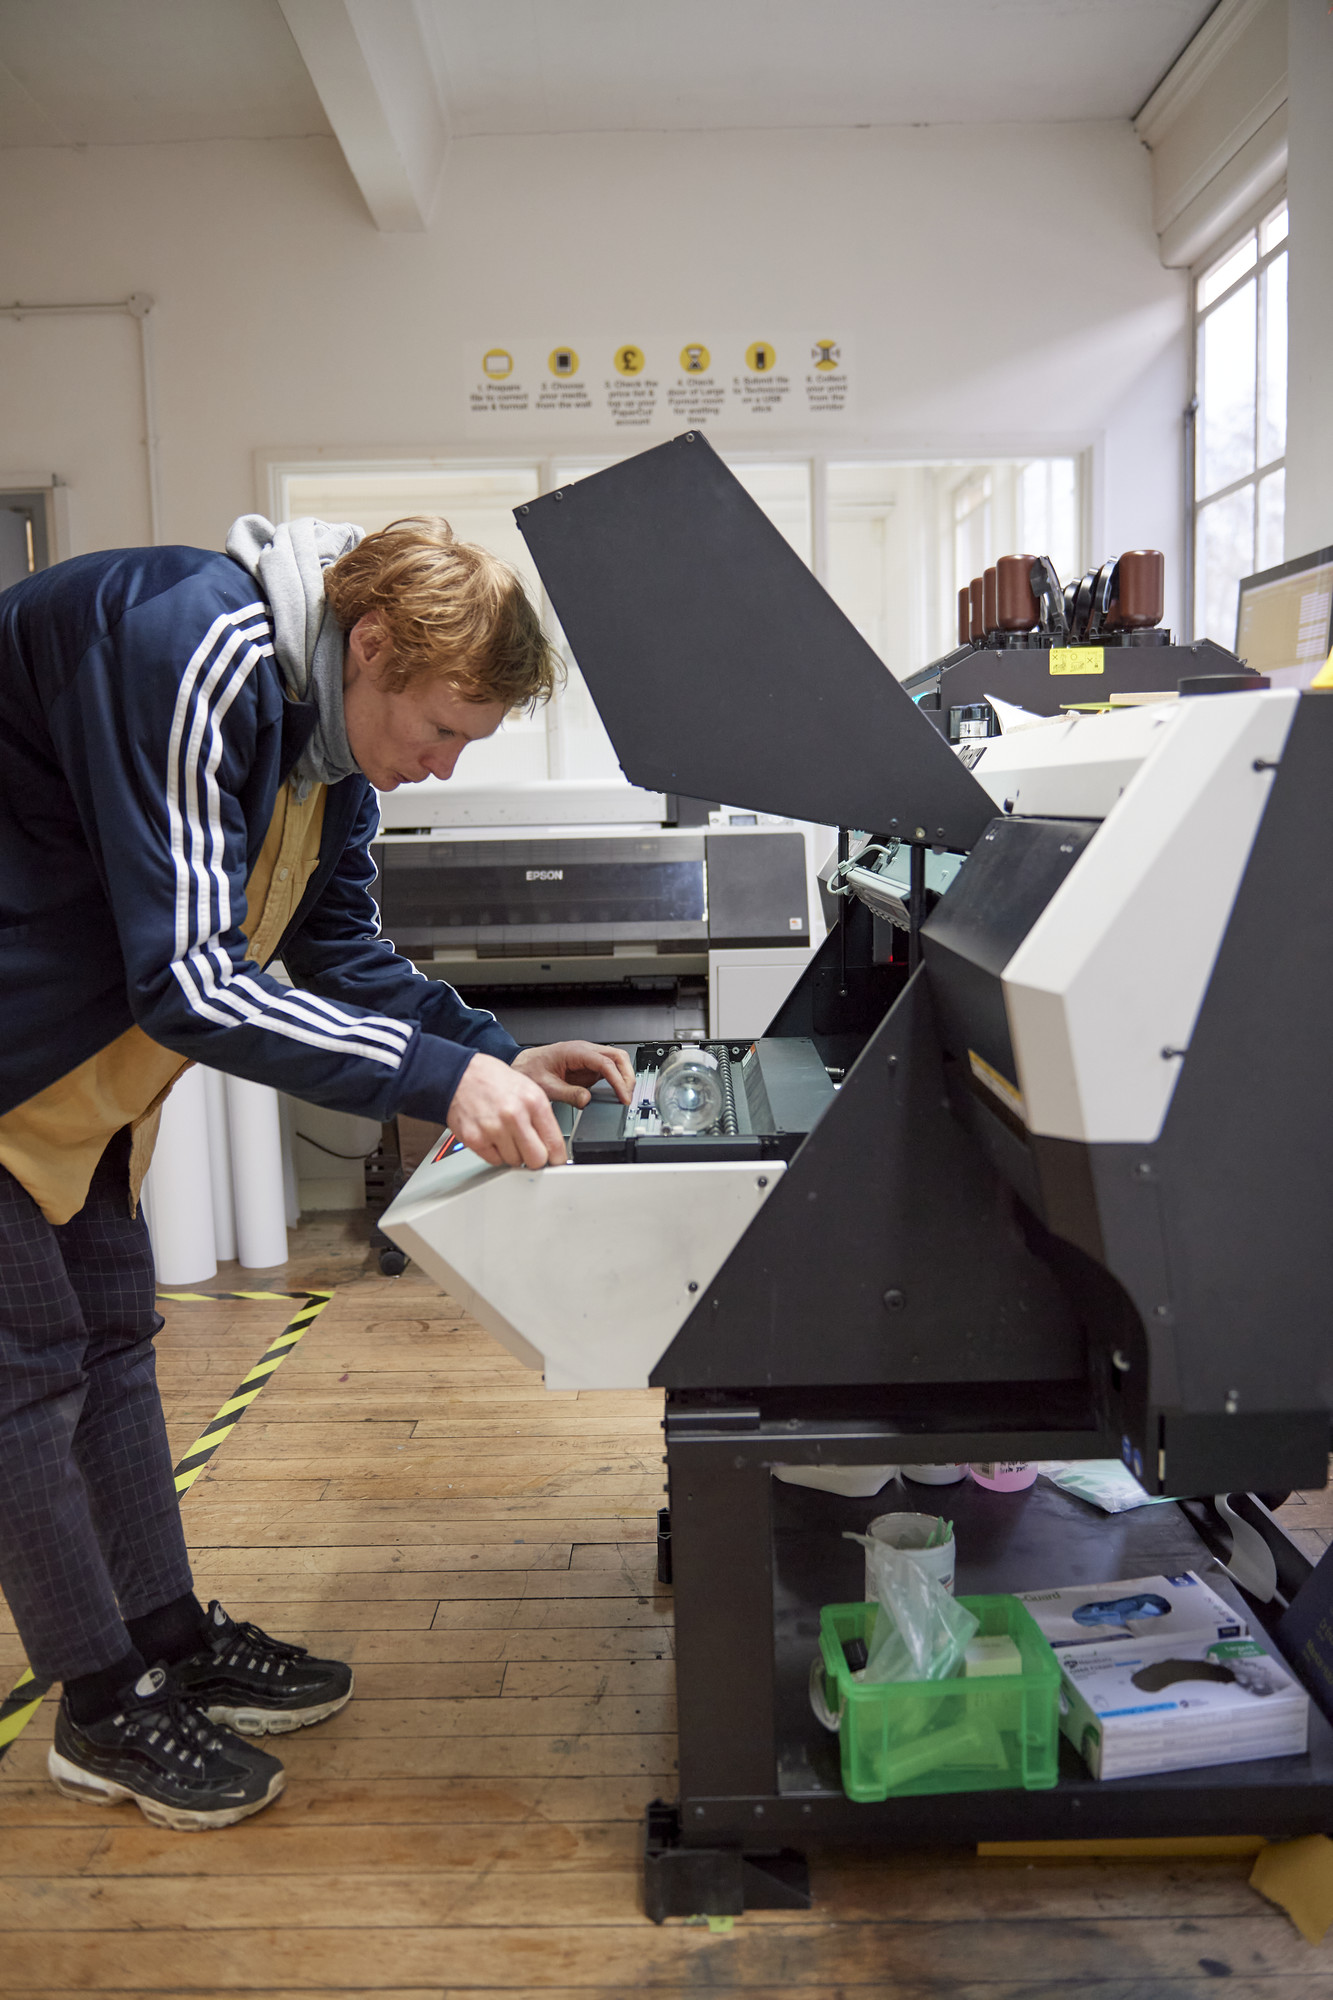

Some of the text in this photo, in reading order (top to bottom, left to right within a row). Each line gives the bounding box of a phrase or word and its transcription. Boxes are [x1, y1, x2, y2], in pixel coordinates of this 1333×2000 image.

[686, 378, 715, 387] Check
[743, 376, 773, 385] Submit
[815, 374, 848, 383] Collect
[551, 381, 585, 390] Choose
[614, 380, 642, 388] Check
[644, 380, 659, 388] the
[561, 391, 587, 399] media
[700, 388, 725, 398] Large
[744, 386, 790, 395] Technician
[808, 394, 845, 402] from the
[575, 400, 592, 409] wall
[751, 405, 772, 413] stick
[809, 404, 845, 412] corridor
[688, 406, 720, 416] waiting
[686, 416, 707, 424] time
[526, 869, 563, 881] EPSON
